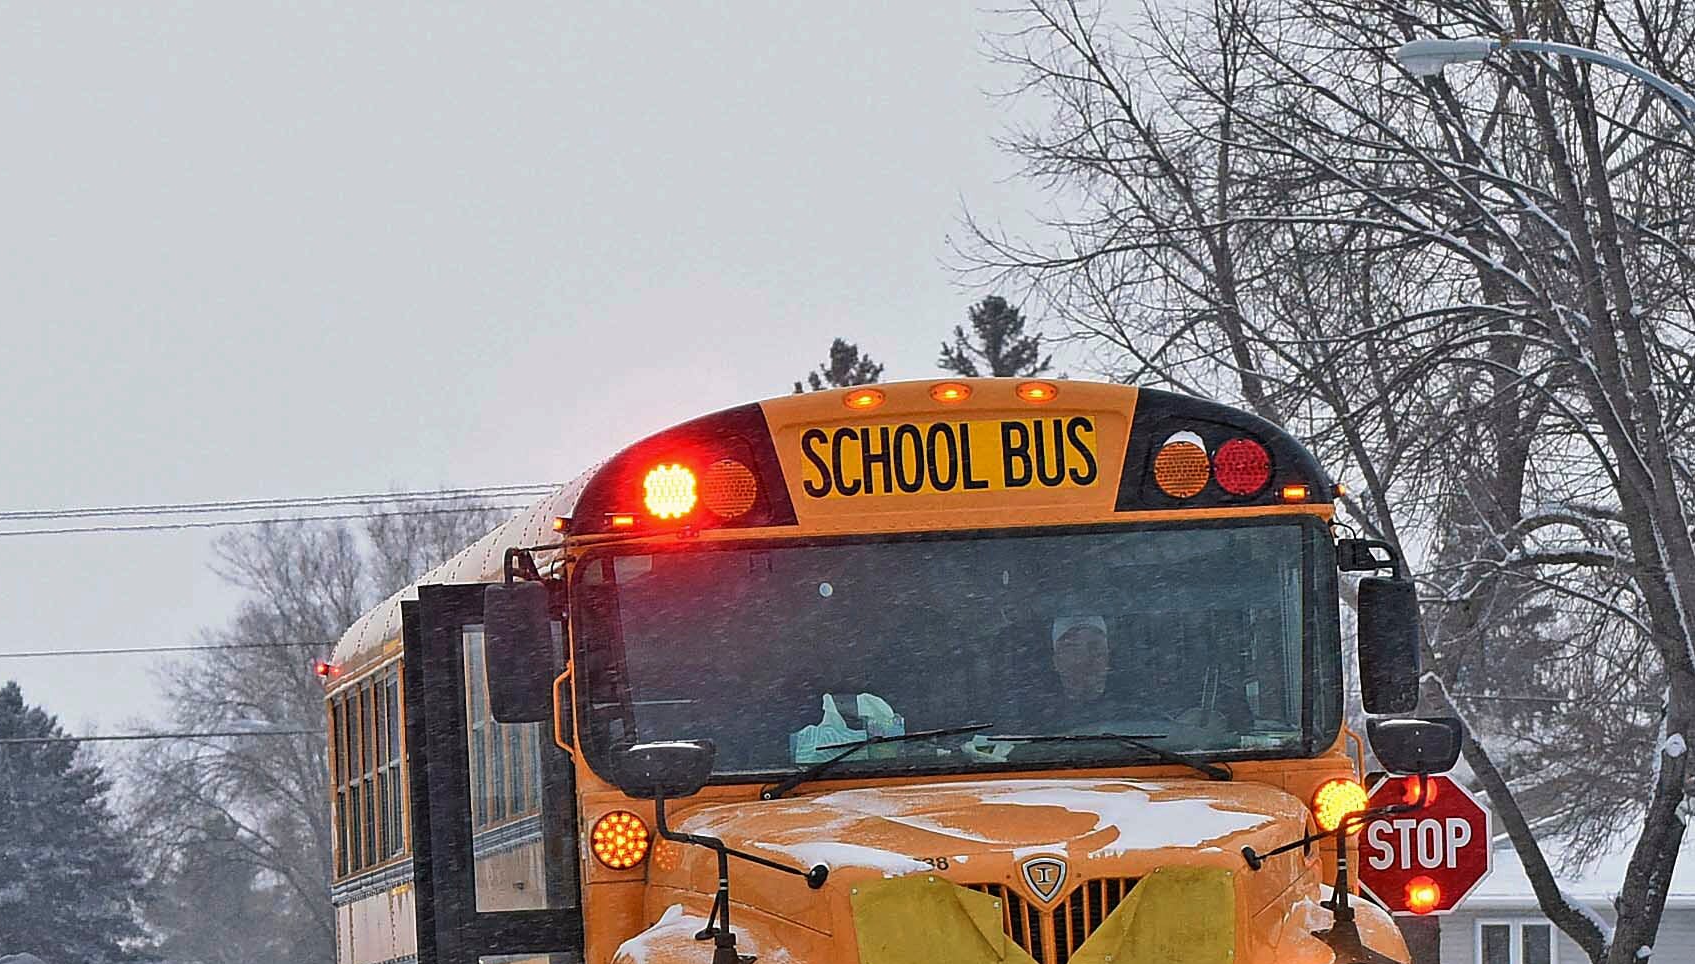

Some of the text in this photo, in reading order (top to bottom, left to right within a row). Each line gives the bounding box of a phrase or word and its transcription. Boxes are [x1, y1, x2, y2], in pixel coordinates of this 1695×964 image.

[801, 416, 1097, 498] SCHOOL BUS
[1367, 817, 1471, 870] STOP
